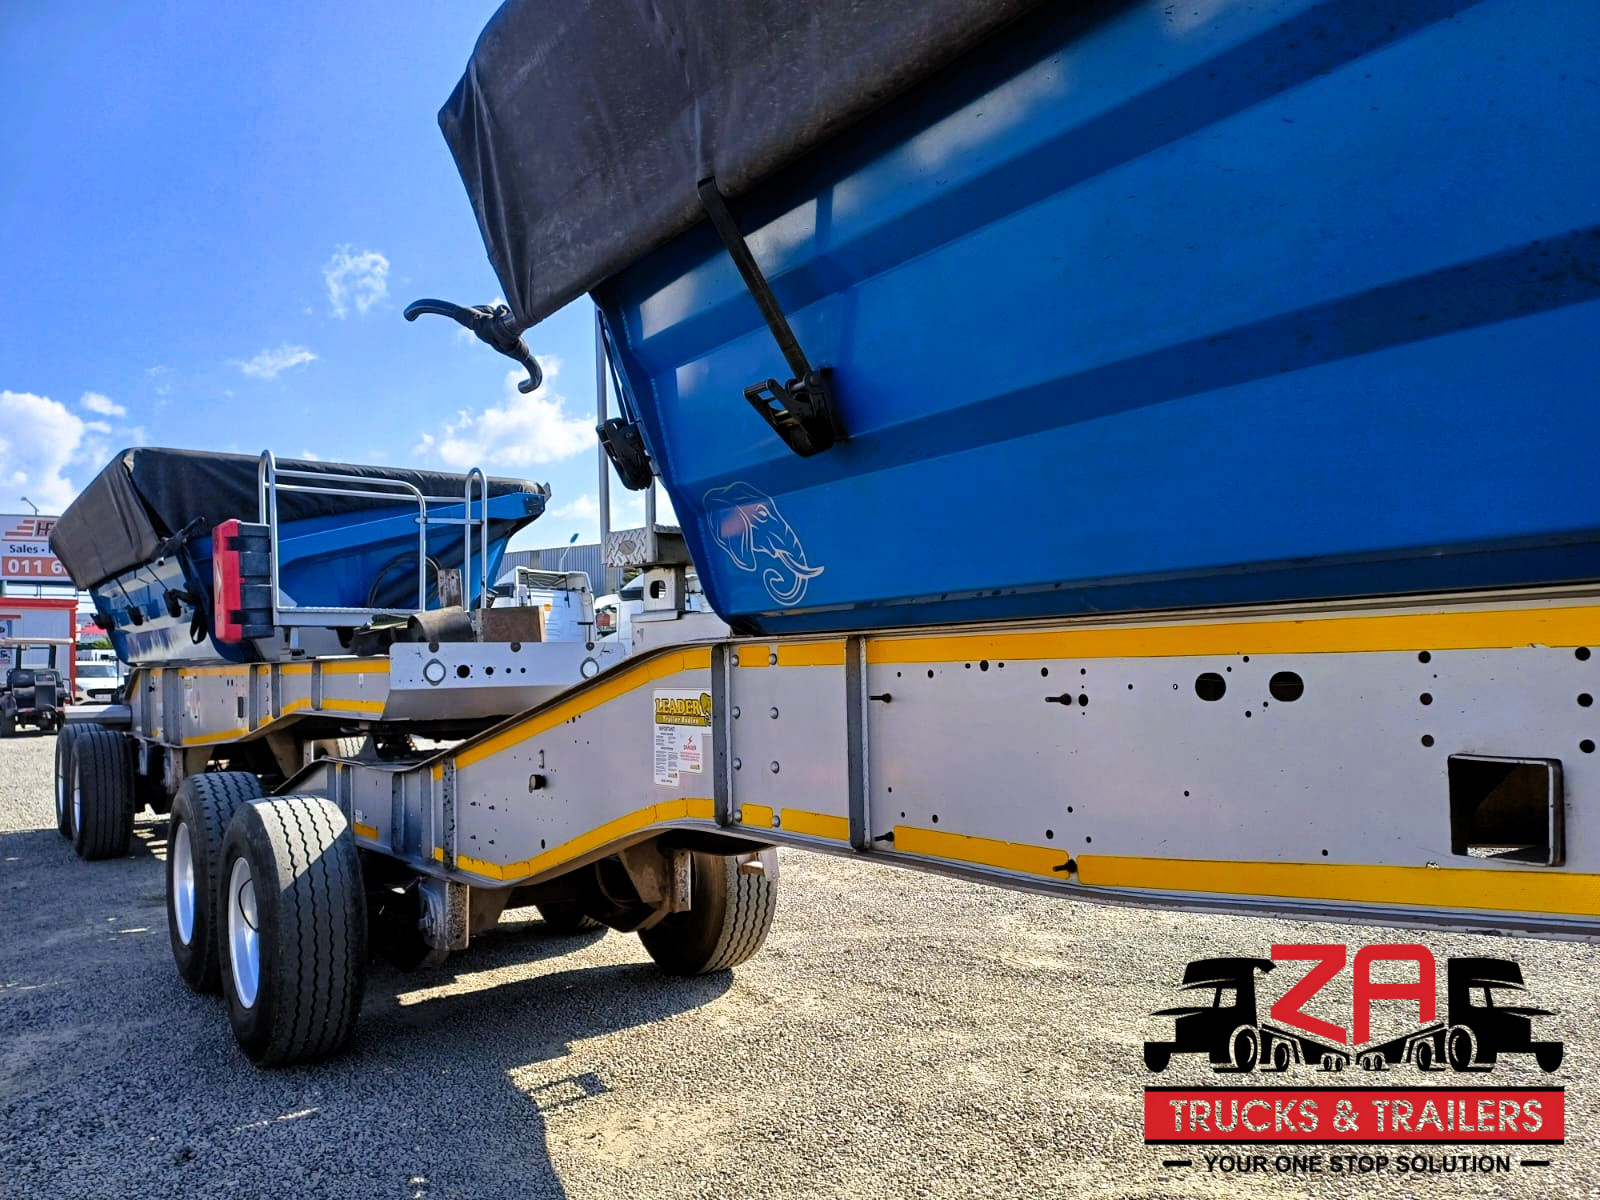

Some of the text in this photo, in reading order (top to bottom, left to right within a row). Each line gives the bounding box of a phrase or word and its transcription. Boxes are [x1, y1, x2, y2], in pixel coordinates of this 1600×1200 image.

[9, 544, 39, 554] Sales
[7, 558, 43, 574] 011
[655, 698, 701, 715] LEADER
